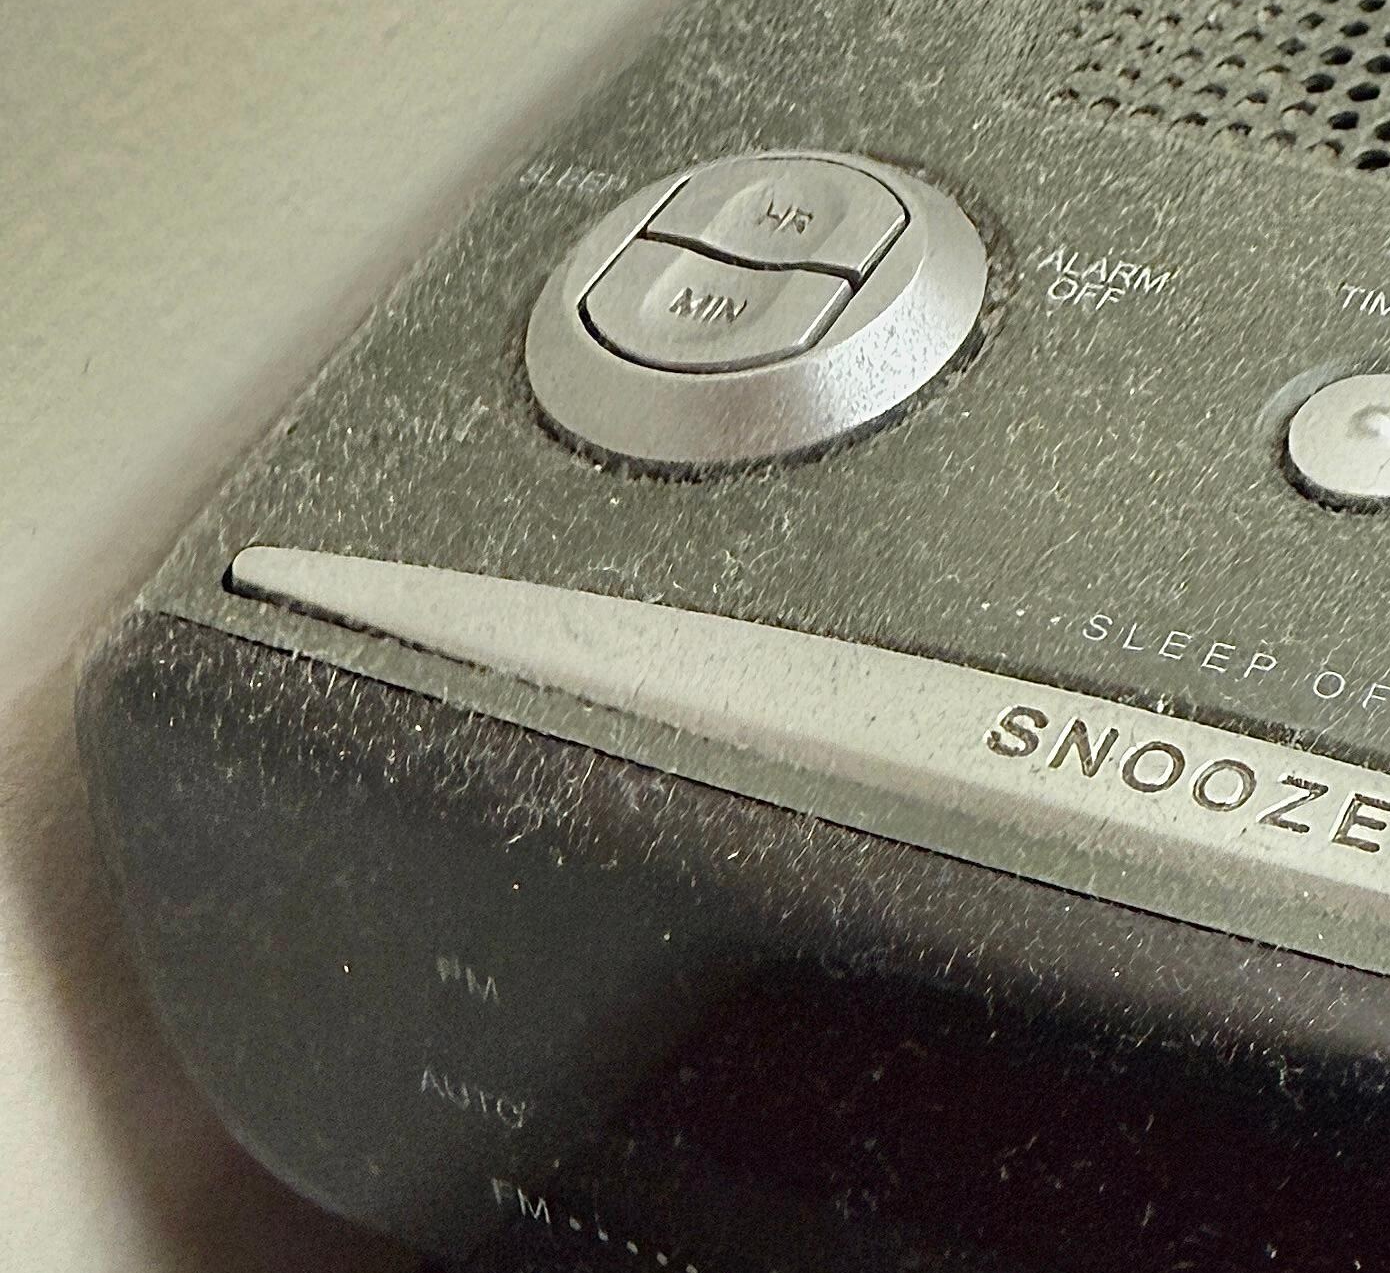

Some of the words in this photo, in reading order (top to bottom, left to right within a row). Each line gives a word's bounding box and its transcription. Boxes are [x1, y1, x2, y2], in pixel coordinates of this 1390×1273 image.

[1037, 242, 1171, 294] ALARM
[667, 286, 748, 323] MIN
[1047, 274, 1126, 311] OFF
[1081, 613, 1278, 680] SLEEP
